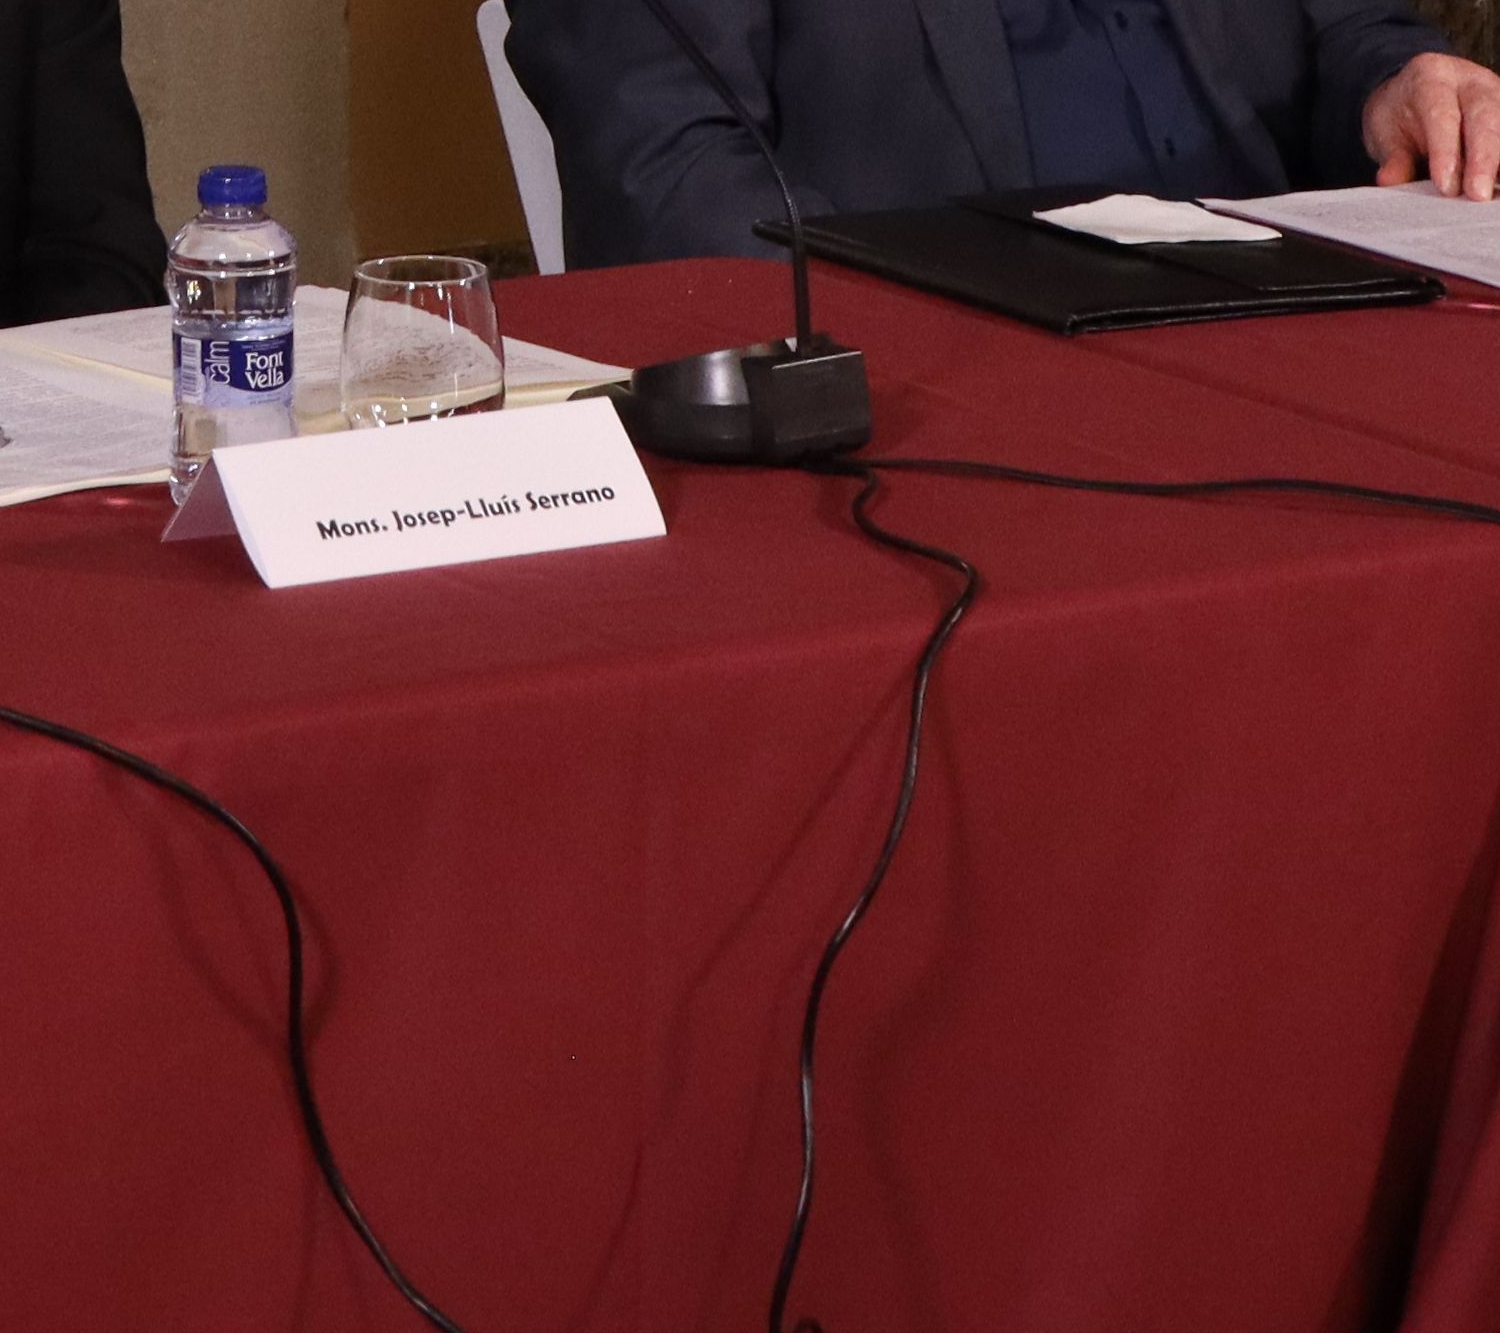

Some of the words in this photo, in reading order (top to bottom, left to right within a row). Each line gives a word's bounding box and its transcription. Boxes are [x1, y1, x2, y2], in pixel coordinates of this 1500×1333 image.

[204, 340, 231, 385] calm
[245, 351, 284, 371] Font
[244, 367, 285, 390] Vella
[316, 517, 388, 541] Mons.
[392, 495, 521, 532] Josep-Lluís
[525, 484, 616, 511] Serrano
